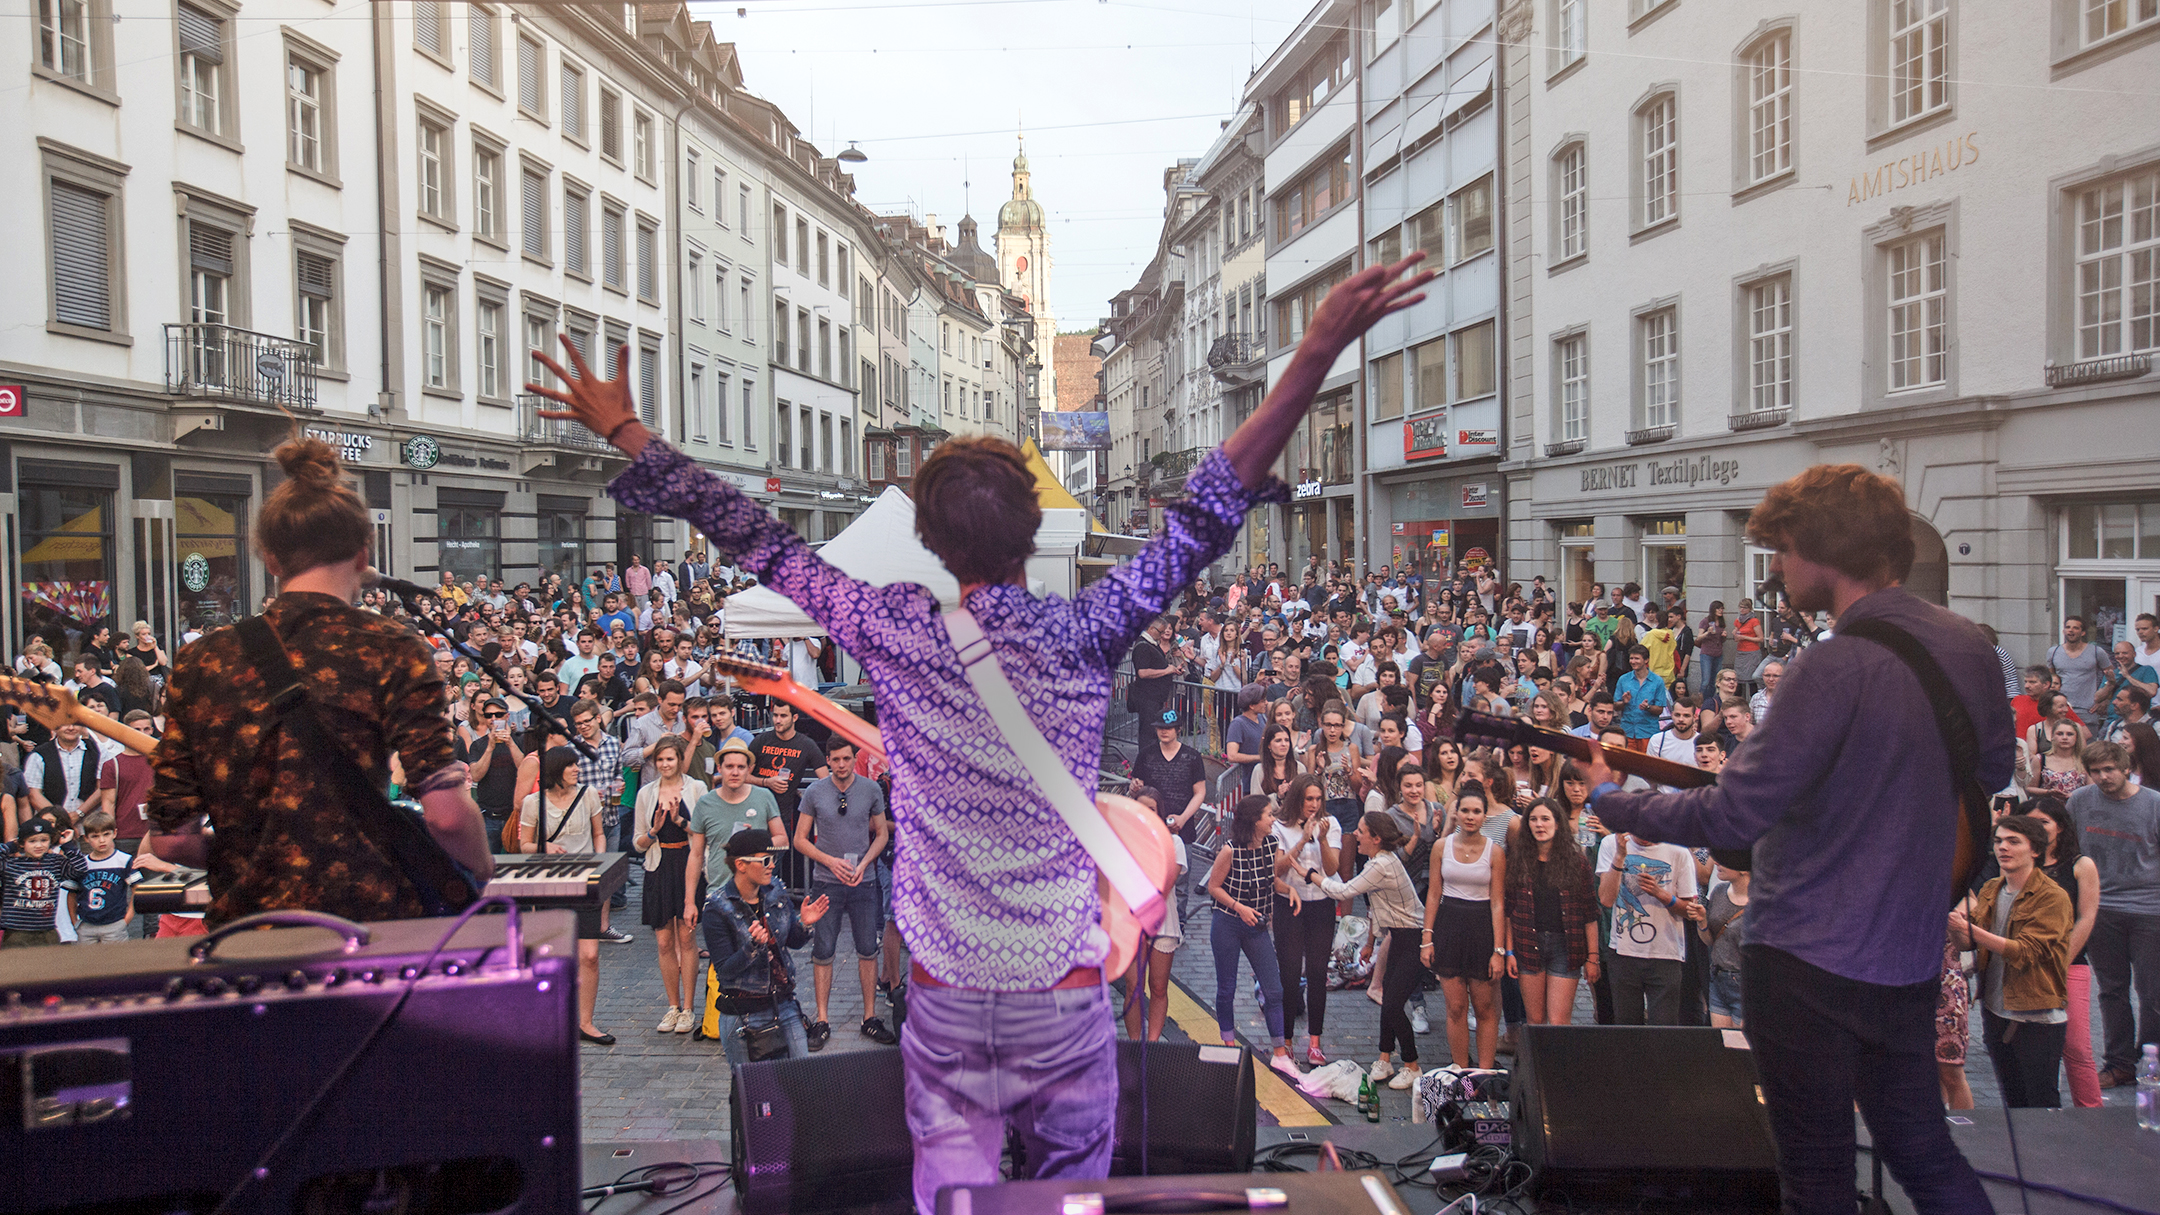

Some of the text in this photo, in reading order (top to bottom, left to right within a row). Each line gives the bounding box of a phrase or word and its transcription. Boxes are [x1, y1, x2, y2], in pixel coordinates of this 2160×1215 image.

[1847, 131, 1979, 207] AMTSHAUS
[306, 429, 373, 449] STARBUCKS
[1580, 455, 1739, 492] BERNET Textilpflege
[1297, 479, 1321, 497] zebra
[762, 745, 802, 758] FREDPERRY
[97, 871, 121, 885] FRAN
[88, 888, 106, 910] 6
